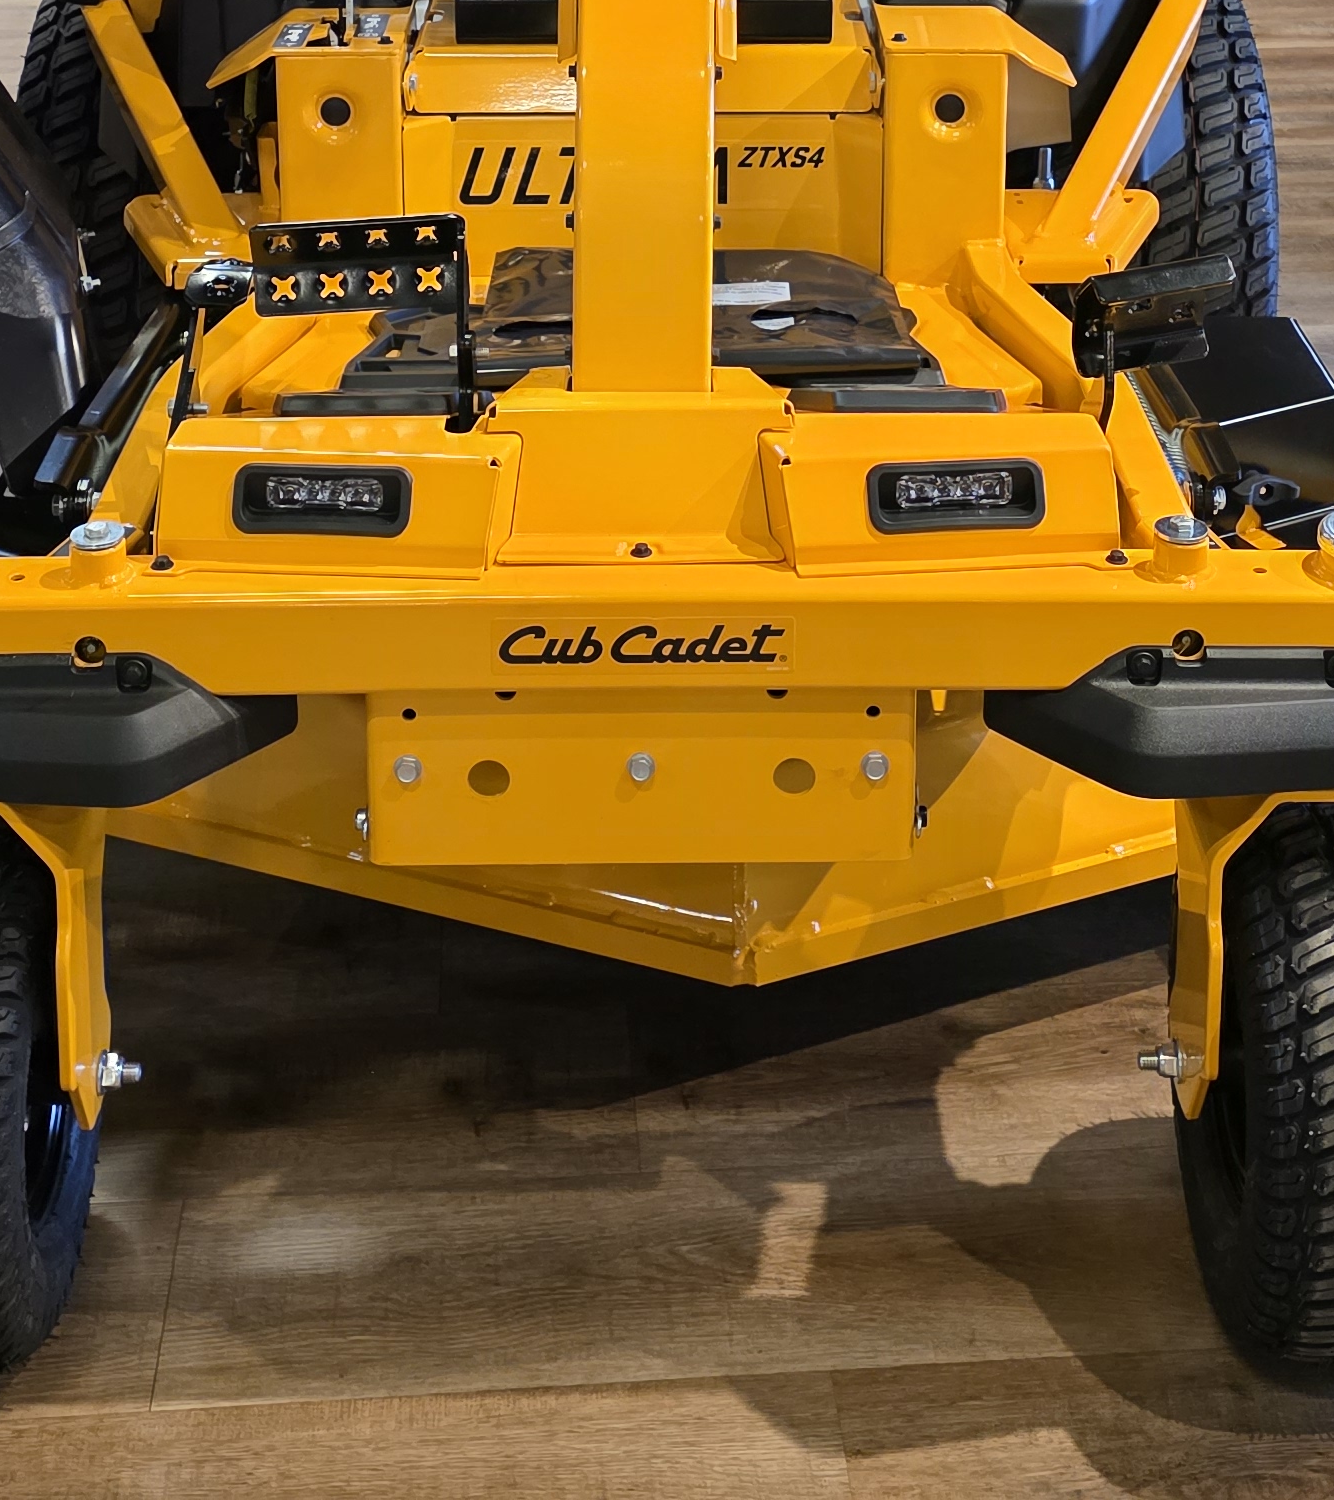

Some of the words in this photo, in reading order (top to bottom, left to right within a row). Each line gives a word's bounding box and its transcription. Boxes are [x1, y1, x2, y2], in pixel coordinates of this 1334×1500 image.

[738, 146, 825, 169] ZTXS4
[499, 625, 603, 664] Cub
[610, 624, 785, 664] Cadet
